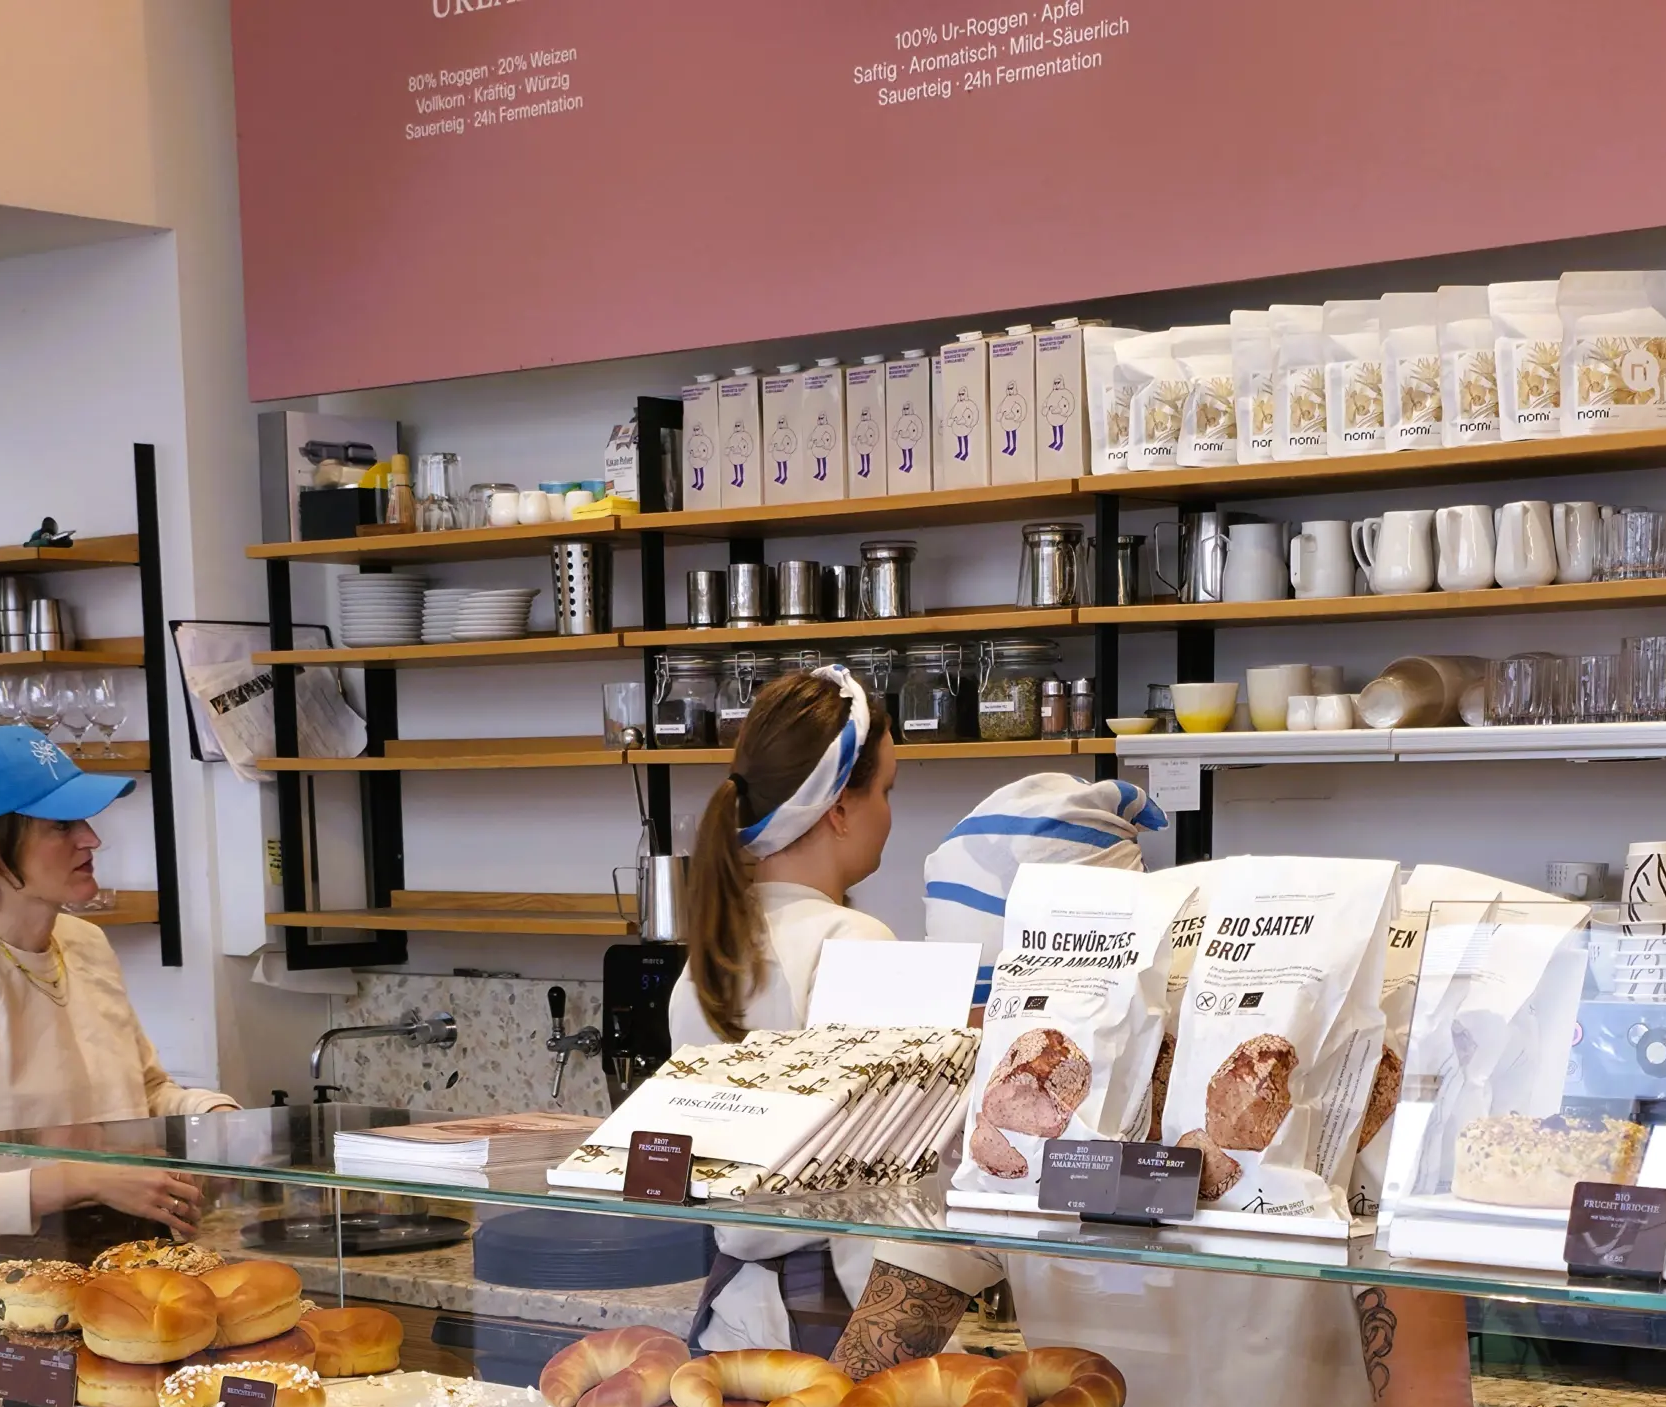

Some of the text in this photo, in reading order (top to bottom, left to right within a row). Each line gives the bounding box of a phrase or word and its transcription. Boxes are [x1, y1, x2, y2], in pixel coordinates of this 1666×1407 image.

[894, 0, 1084, 50] 100% Ur-Roggen Apfel
[853, 16, 1130, 85] Saftig Aromatisch Mild-Säuerlich
[408, 47, 578, 93] 80% Roggen 20% Weizen
[878, 51, 1102, 106] Sauerteig 24h Fermentation
[416, 72, 570, 115] Vollkorn Kräftig Würzig
[405, 95, 583, 140] Sauerteig 24h Fermentation
[1216, 914, 1315, 938] BIO SAATEN
[1022, 929, 1047, 951] BIO
[1205, 939, 1255, 963] BROT
[1012, 953, 1065, 969] HAFER
[997, 962, 1043, 978] BROT
[711, 1091, 743, 1102] ZUM
[668, 1096, 769, 1116] FRISCHHALTEN
[1049, 1152, 1114, 1163] GEWÜRZTES HAFER
[1076, 1146, 1089, 1154] BIO
[1156, 1151, 1169, 1159] BIO
[1051, 1160, 1111, 1171] AMARANTH BROT
[1137, 1158, 1185, 1168] SAATEN BROT
[1288, 1199, 1305, 1210] BROT
[1615, 1193, 1631, 1202] BIO
[1583, 1199, 1661, 1214] FRUCHT BRIOCHE
